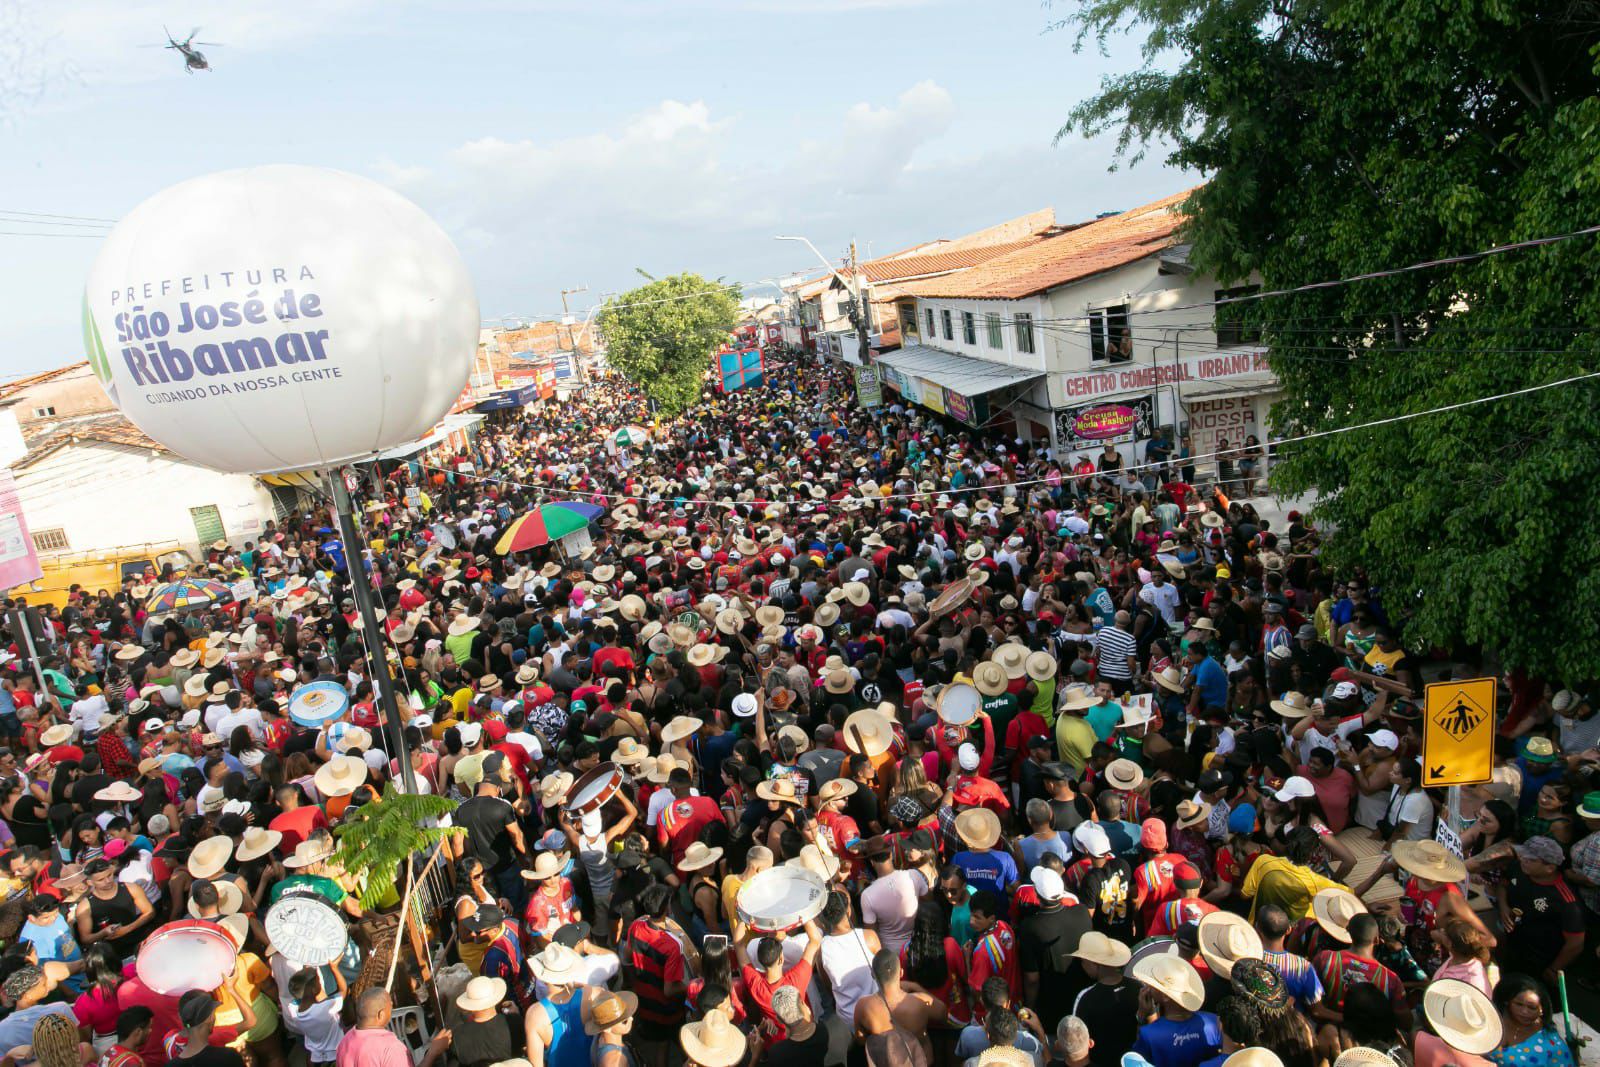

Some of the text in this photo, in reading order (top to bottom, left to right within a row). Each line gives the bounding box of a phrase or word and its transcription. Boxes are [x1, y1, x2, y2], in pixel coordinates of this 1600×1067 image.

[111, 265, 315, 306] PREFEITURA
[115, 289, 323, 342] São José de
[121, 329, 329, 386] Ribamar
[1066, 372, 1117, 396] CENTRO
[1120, 362, 1195, 389] COMERCIAL
[1198, 354, 1250, 378] URBANO
[145, 367, 343, 405] CUIDANDO DA NOSSA GENTE
[1191, 398, 1235, 413] DEUS
[1077, 420, 1098, 431] Moda
[1191, 411, 1255, 430] NOSSA
